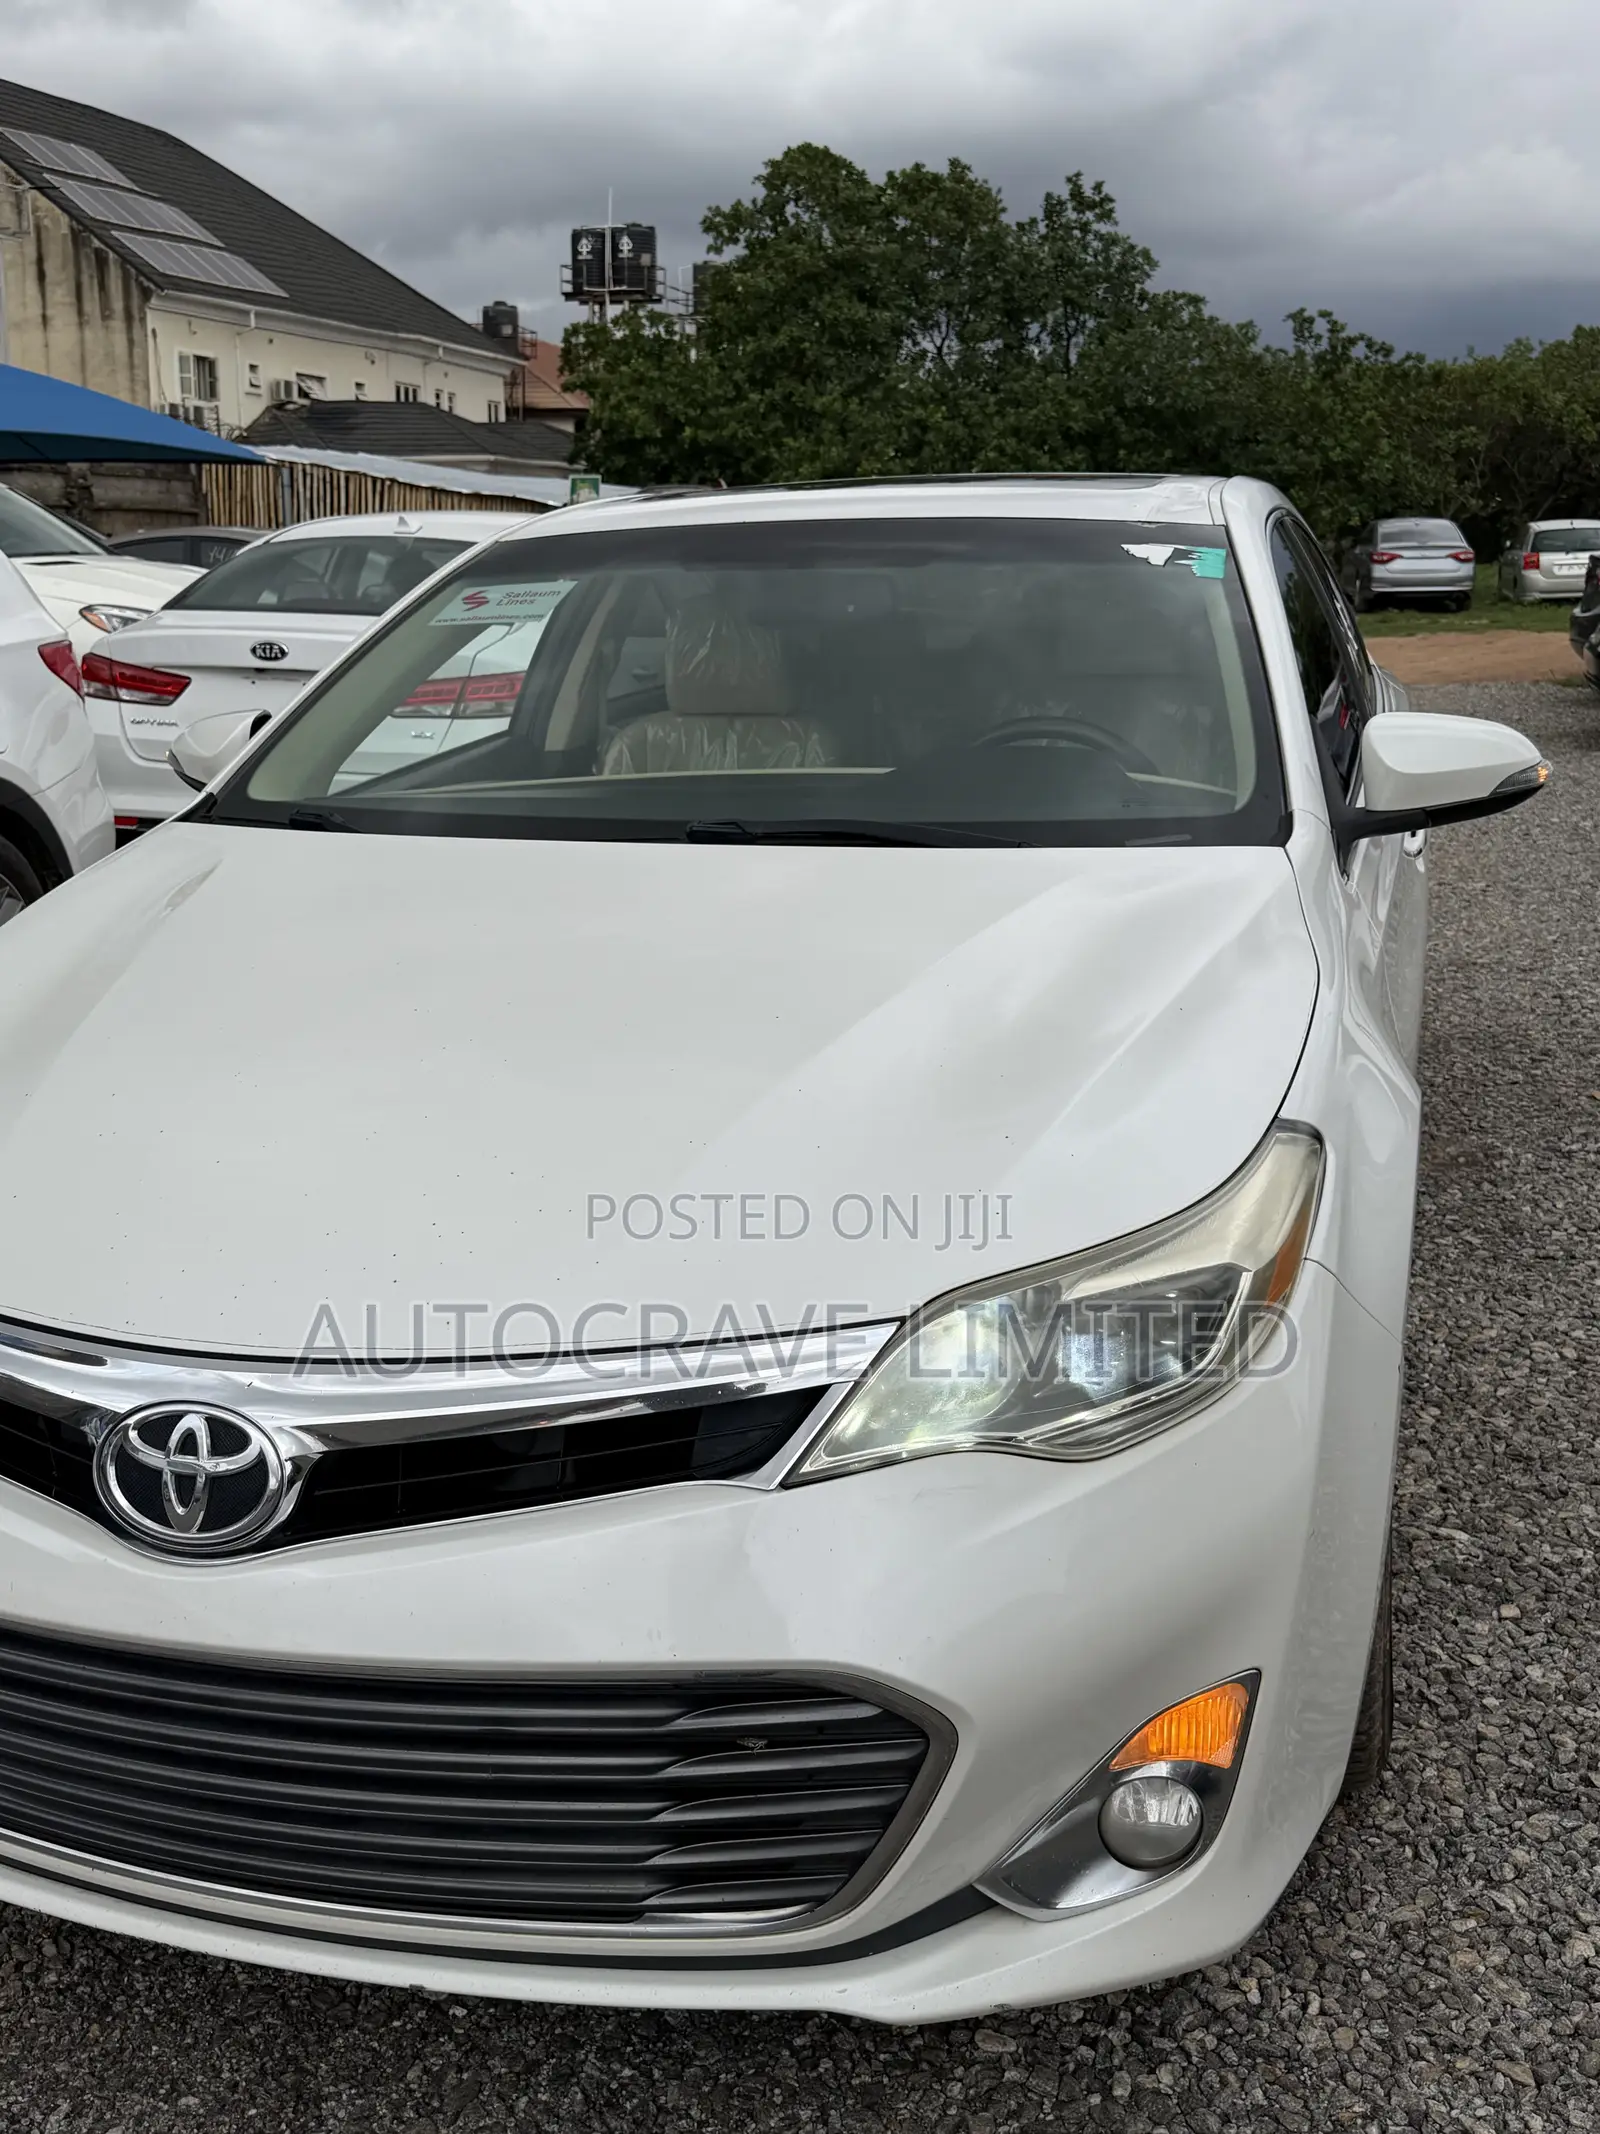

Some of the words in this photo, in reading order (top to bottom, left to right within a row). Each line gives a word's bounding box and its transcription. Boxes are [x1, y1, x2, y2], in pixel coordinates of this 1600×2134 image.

[502, 590, 561, 599] Sallaum
[496, 598, 536, 606] Lines
[255, 644, 282, 658] KIA
